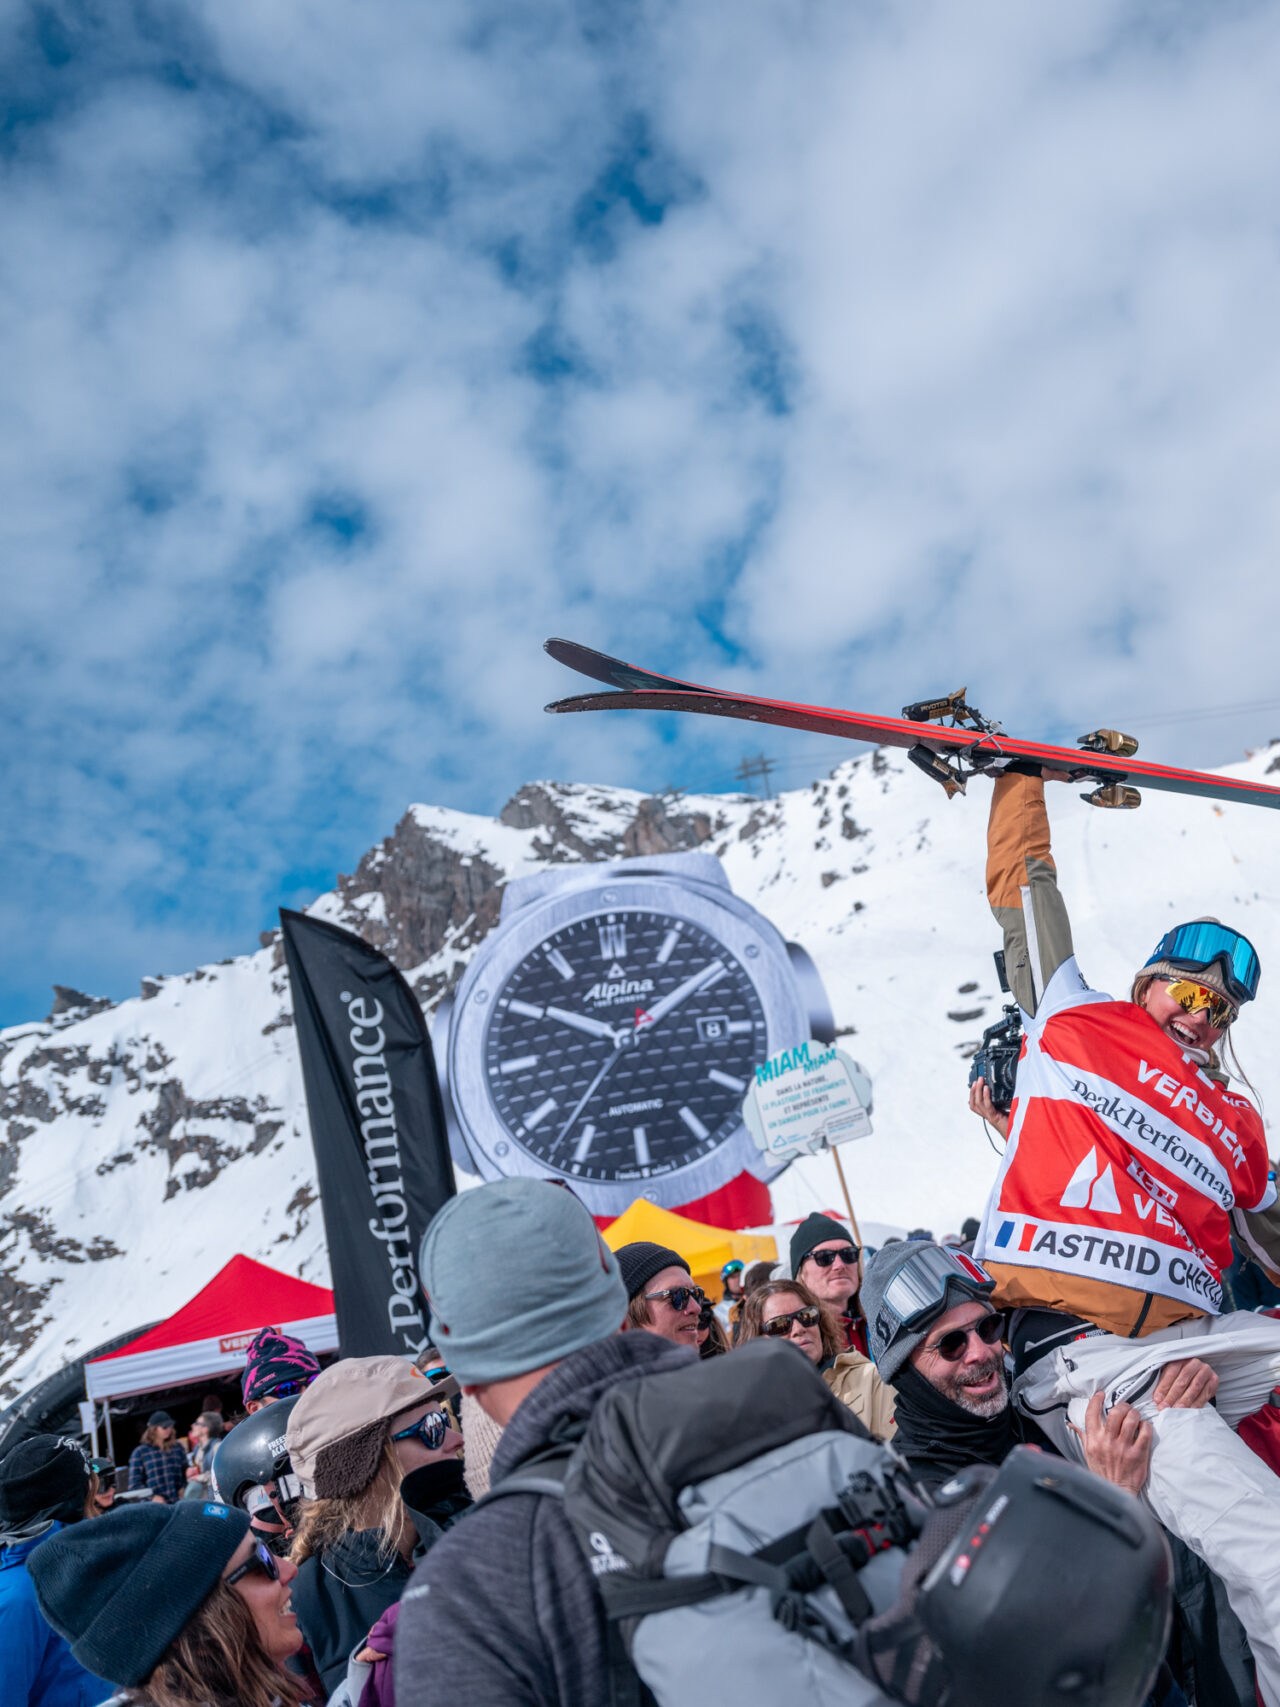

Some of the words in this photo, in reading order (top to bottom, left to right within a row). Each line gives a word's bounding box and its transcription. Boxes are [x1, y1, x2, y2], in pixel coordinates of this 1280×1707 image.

[582, 979, 656, 1002] Alpina
[706, 1021, 721, 1038] 8
[755, 1042, 811, 1087] MIAM
[803, 1048, 837, 1075] MIAM
[608, 1098, 664, 1117] AUTOMATIC
[1137, 1059, 1247, 1169] VERBIER
[1033, 1230, 1161, 1276] ASTRID
